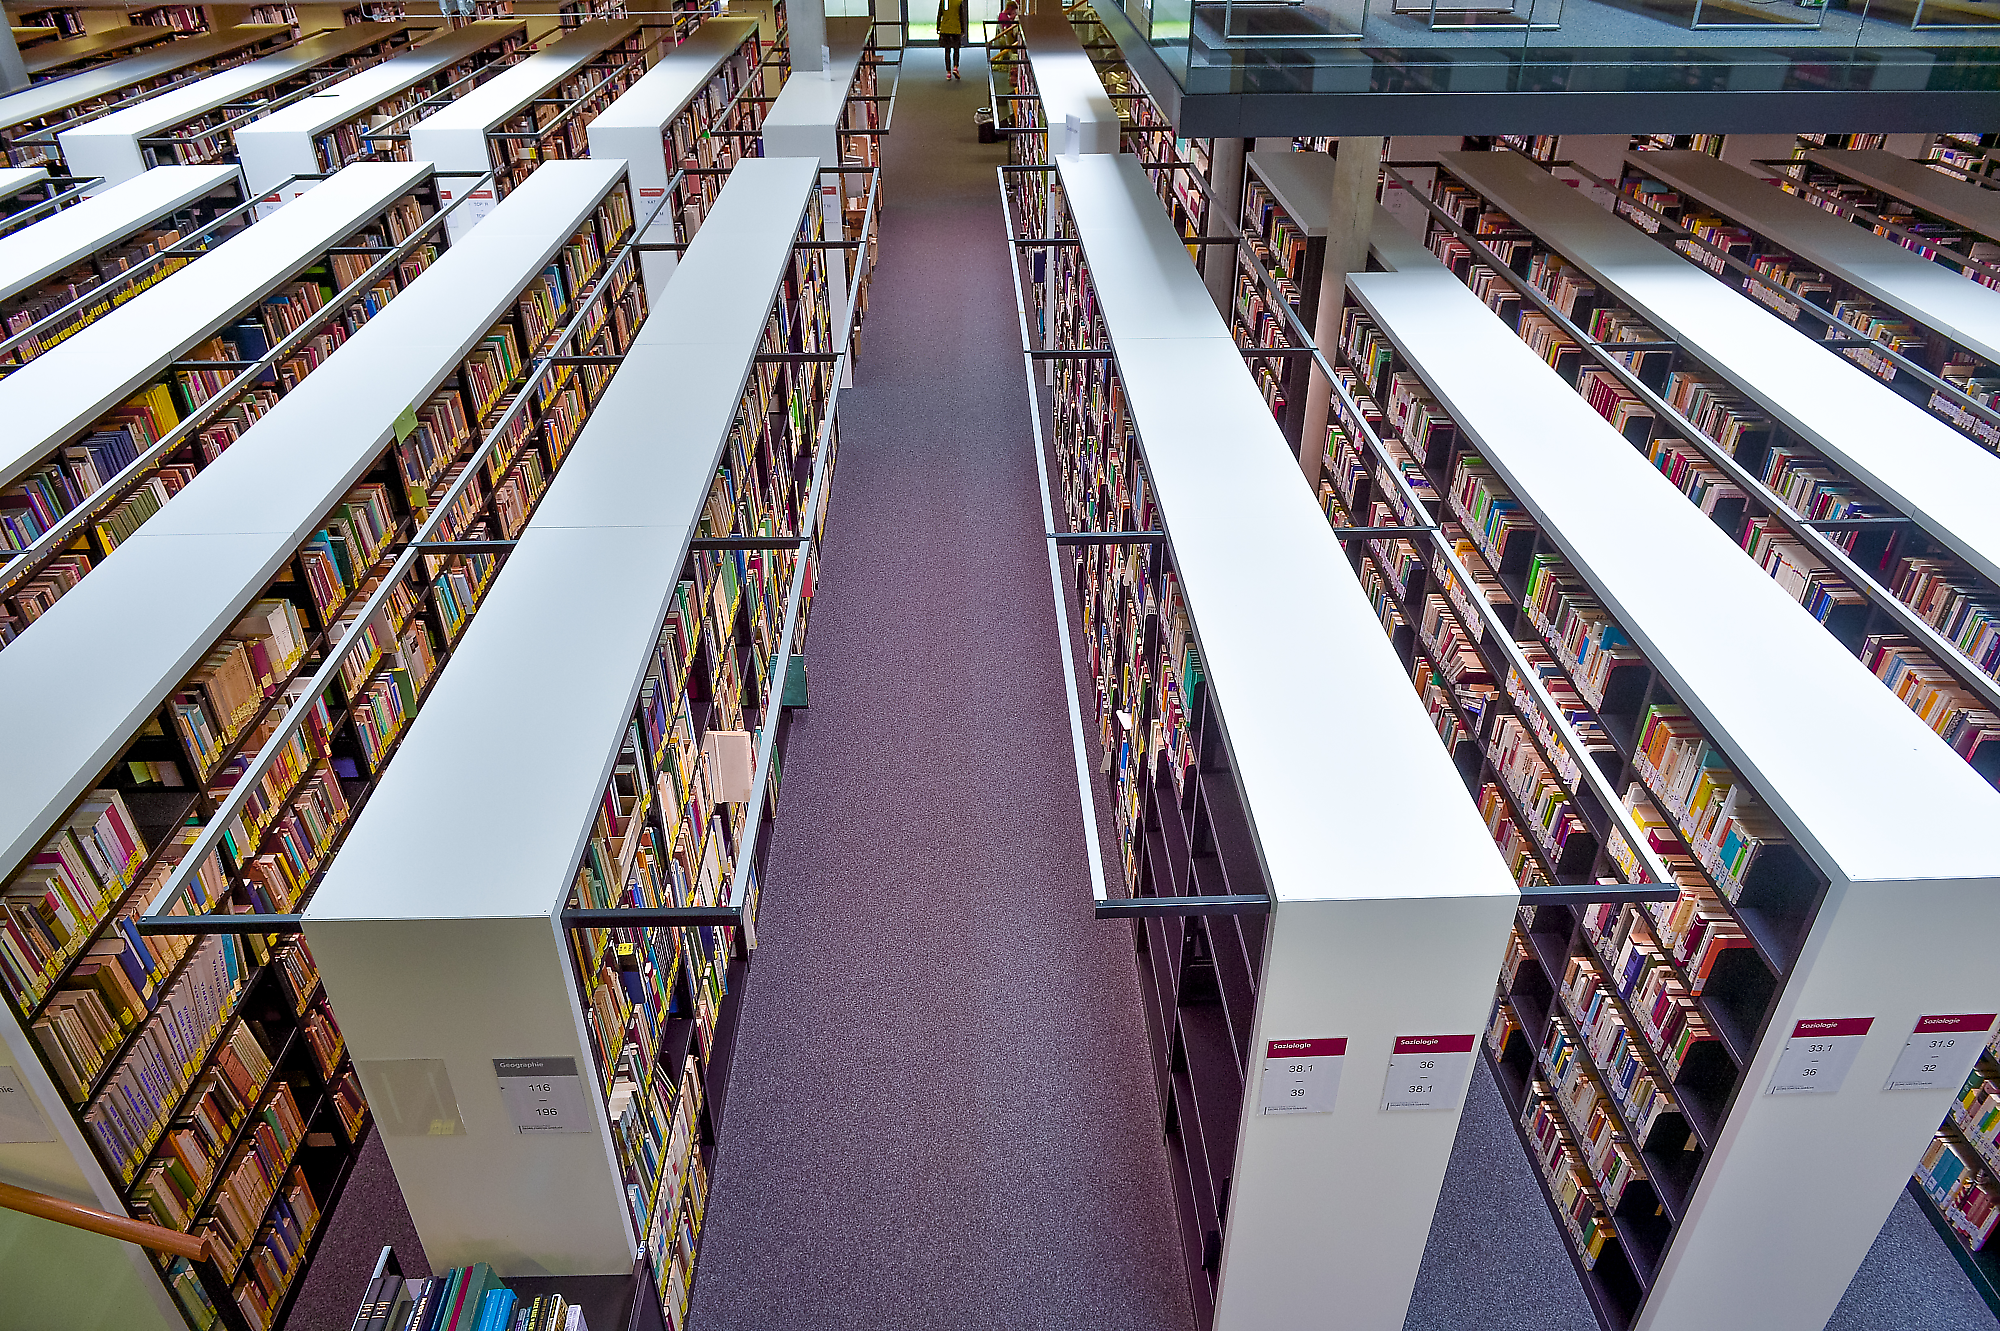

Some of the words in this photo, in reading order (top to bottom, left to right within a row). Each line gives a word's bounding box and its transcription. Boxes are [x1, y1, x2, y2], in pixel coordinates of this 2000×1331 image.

[1800, 1021, 1838, 1030] Soziologie
[1922, 1016, 1961, 1026] Soziologie
[1273, 1042, 1312, 1050] Soziologie
[1400, 1038, 1439, 1046] Soziologie
[1928, 1039, 1955, 1048] 31.9
[1808, 1044, 1834, 1053] 33.1
[499, 1061, 544, 1069] Geographie
[1288, 1064, 1314, 1073] 38.1
[1419, 1060, 1435, 1069] 36
[1921, 1064, 1937, 1073] 32
[1802, 1068, 1818, 1077] 36
[528, 1083, 551, 1092] 116
[1408, 1084, 1434, 1094] 38.1
[1290, 1088, 1306, 1098] 39
[535, 1107, 558, 1117] 196
